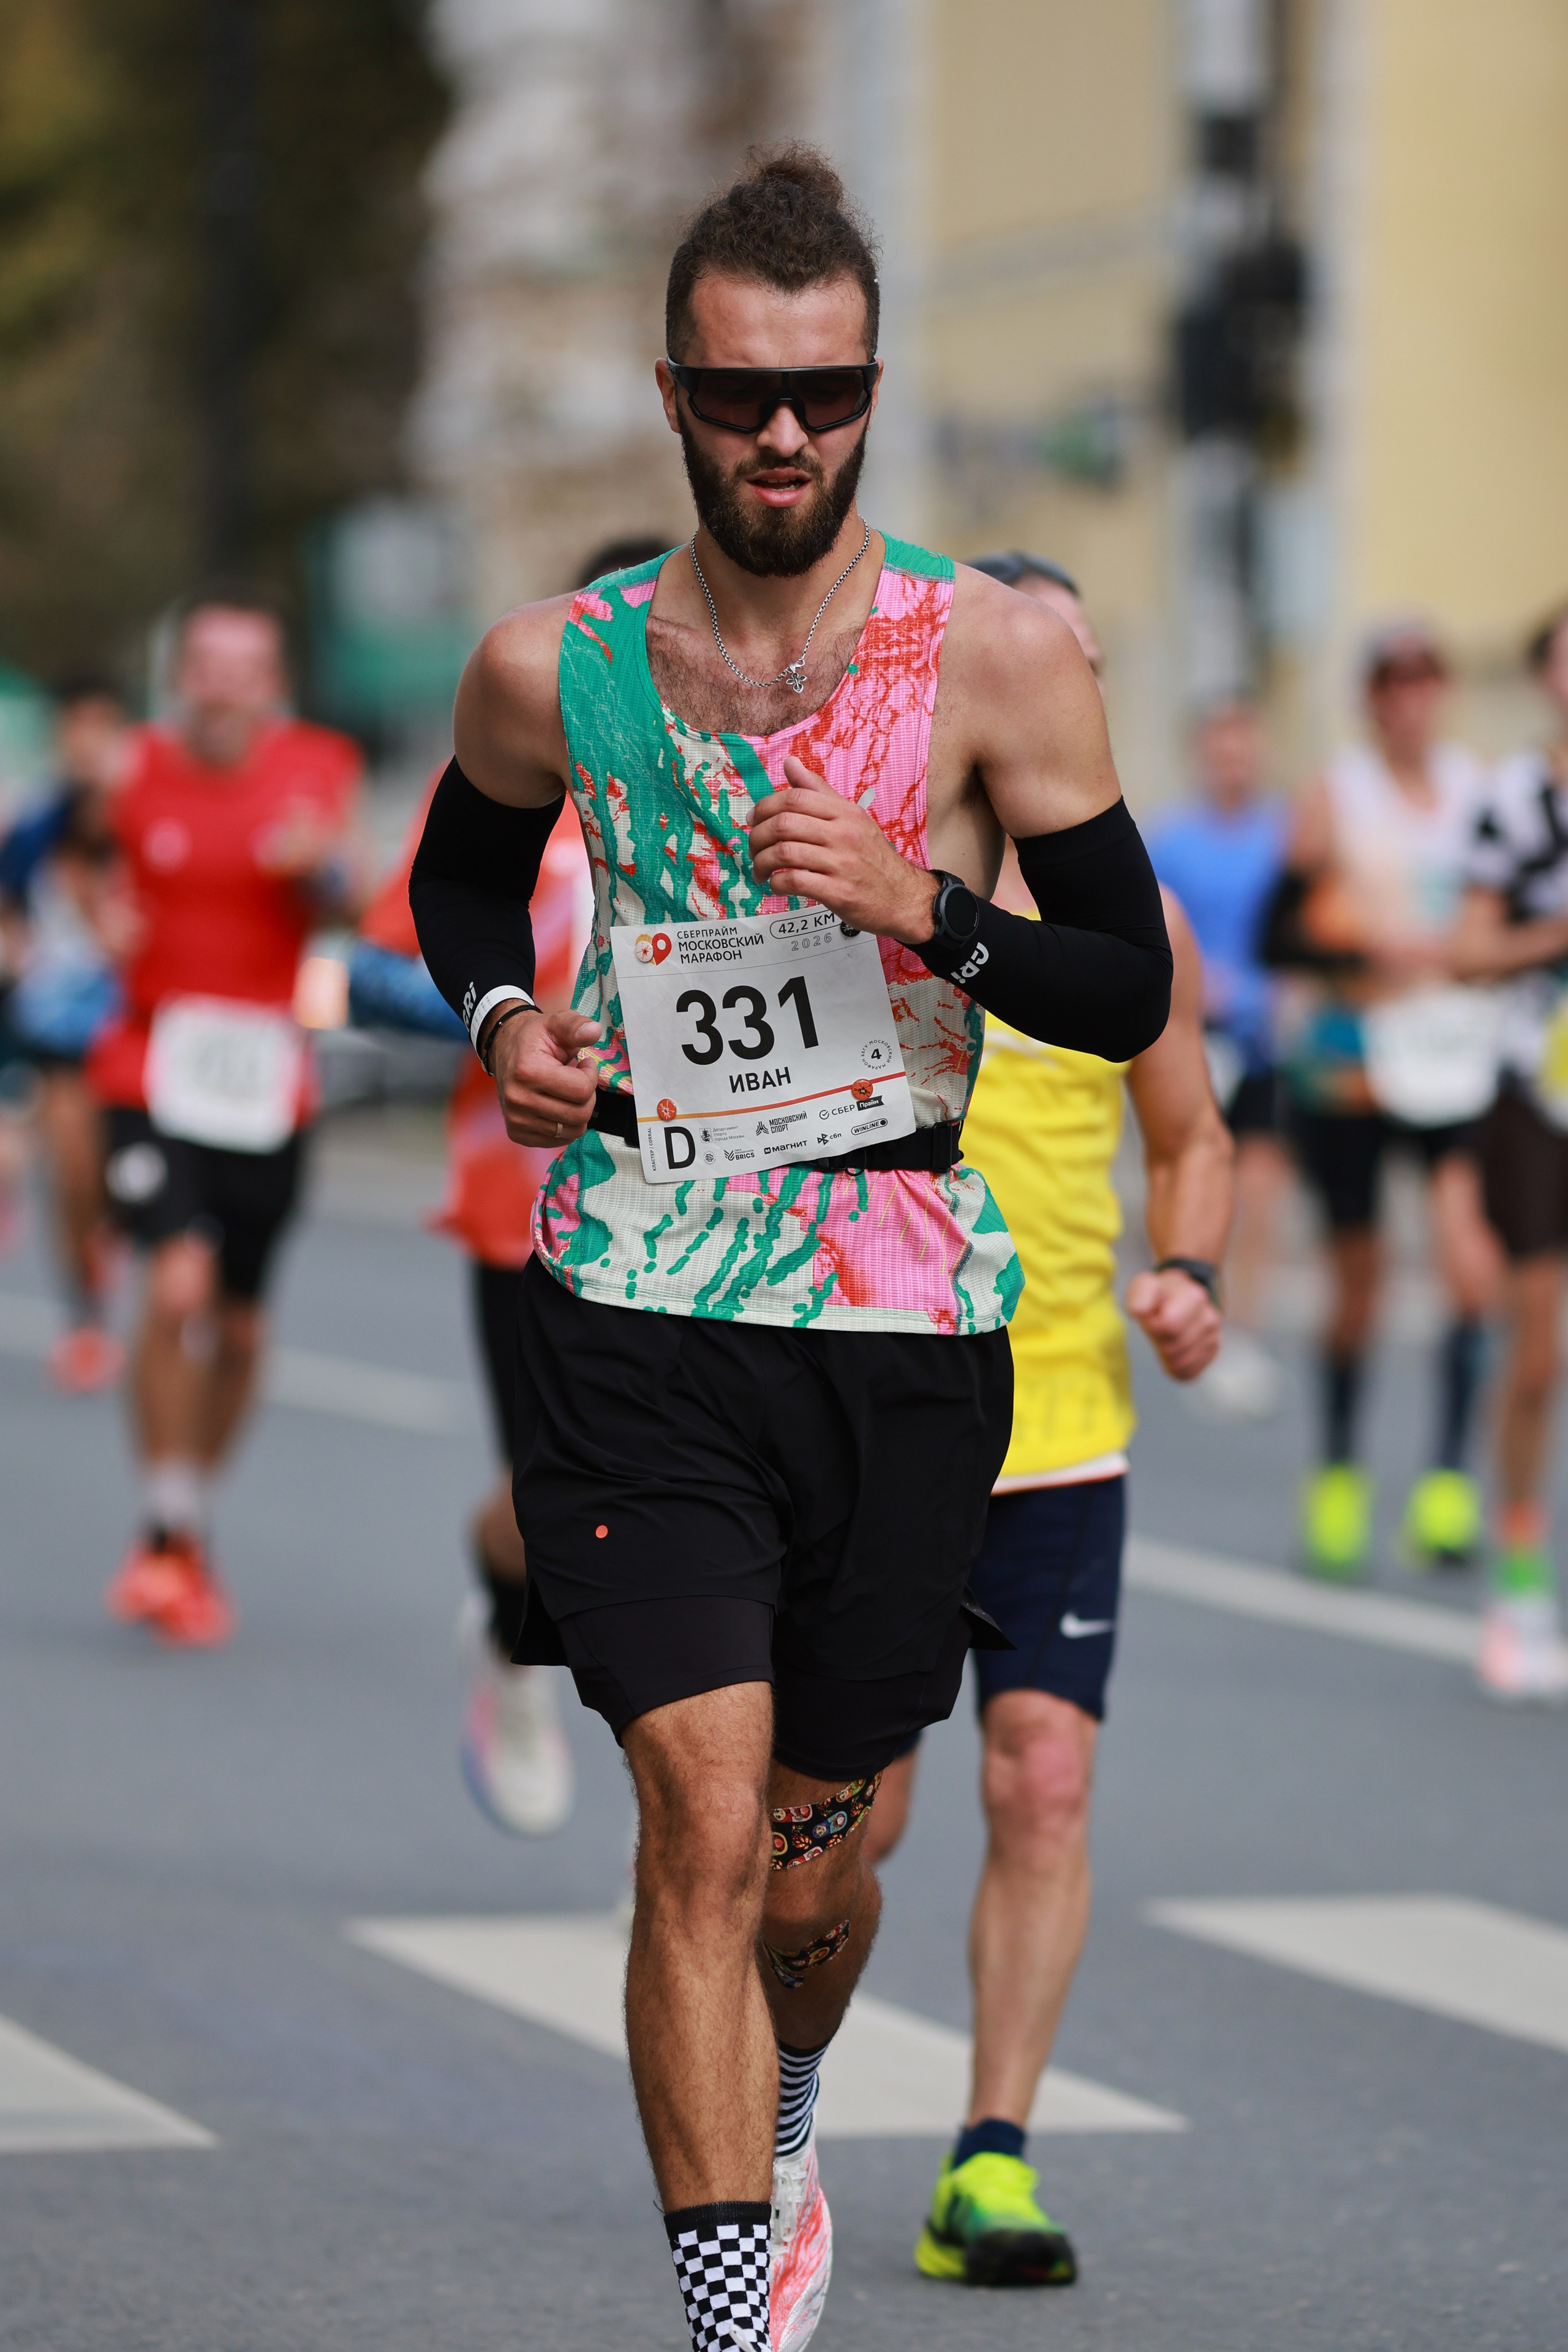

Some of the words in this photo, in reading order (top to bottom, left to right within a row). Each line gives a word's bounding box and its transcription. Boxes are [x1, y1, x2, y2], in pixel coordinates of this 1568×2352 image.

[677, 926, 737, 939] СБЕРПРАЙМ
[778, 919, 808, 934] 42,2
[678, 933, 764, 952] МОСКОВСКИЙ
[791, 932, 832, 951] 2026
[680, 949, 742, 964] МАРАФОН
[676, 976, 819, 1065] 331
[871, 1048, 882, 1060] 4
[729, 1066, 791, 1093] ИВАН
[831, 1104, 855, 1115] СБЕР
[859, 1099, 879, 1108] Прайм
[769, 1110, 807, 1126] МОСКОВСКИЙ
[771, 1123, 788, 1134] СПОРТ
[854, 1121, 880, 1134] WINLINE
[663, 1126, 696, 1170] D
[772, 1140, 807, 1152] магнит
